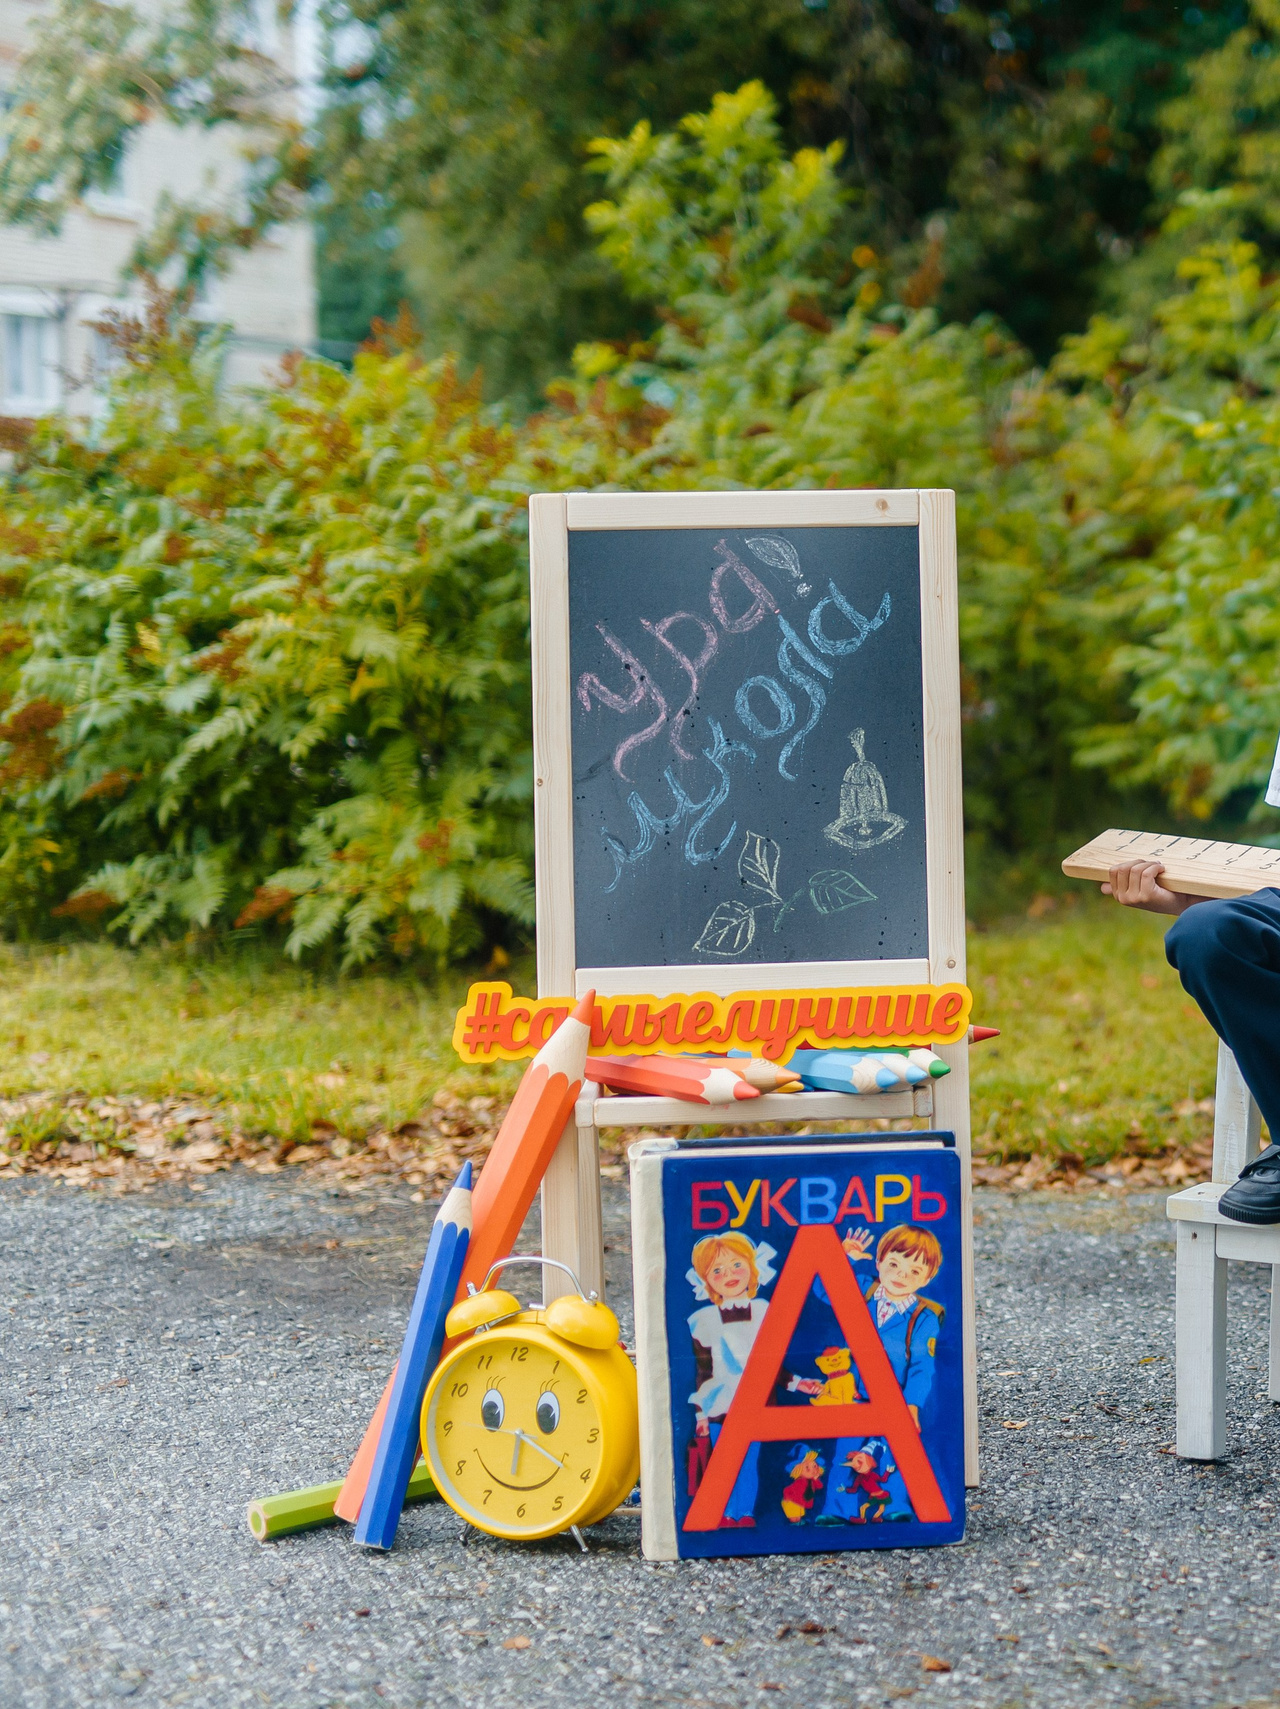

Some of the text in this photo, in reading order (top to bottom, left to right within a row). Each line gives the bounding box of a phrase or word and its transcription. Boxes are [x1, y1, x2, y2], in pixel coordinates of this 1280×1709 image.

[1149, 848, 1163, 856] 2
[1225, 858, 1238, 866] 4
[463, 991, 963, 1060] #самыелучшие
[691, 1174, 948, 1230] БУКВАРЬ
[511, 1346, 528, 1362] 12
[477, 1355, 493, 1370] 11
[552, 1360, 559, 1374] 1
[682, 1224, 952, 1531] А
[451, 1383, 469, 1398] 10
[576, 1389, 588, 1404] 2
[443, 1421, 453, 1437] 9
[586, 1428, 600, 1444] 3
[455, 1460, 467, 1476] 8
[580, 1468, 591, 1483] 4
[482, 1489, 492, 1505] 7
[552, 1495, 564, 1511] 5
[516, 1502, 526, 1518] 6
